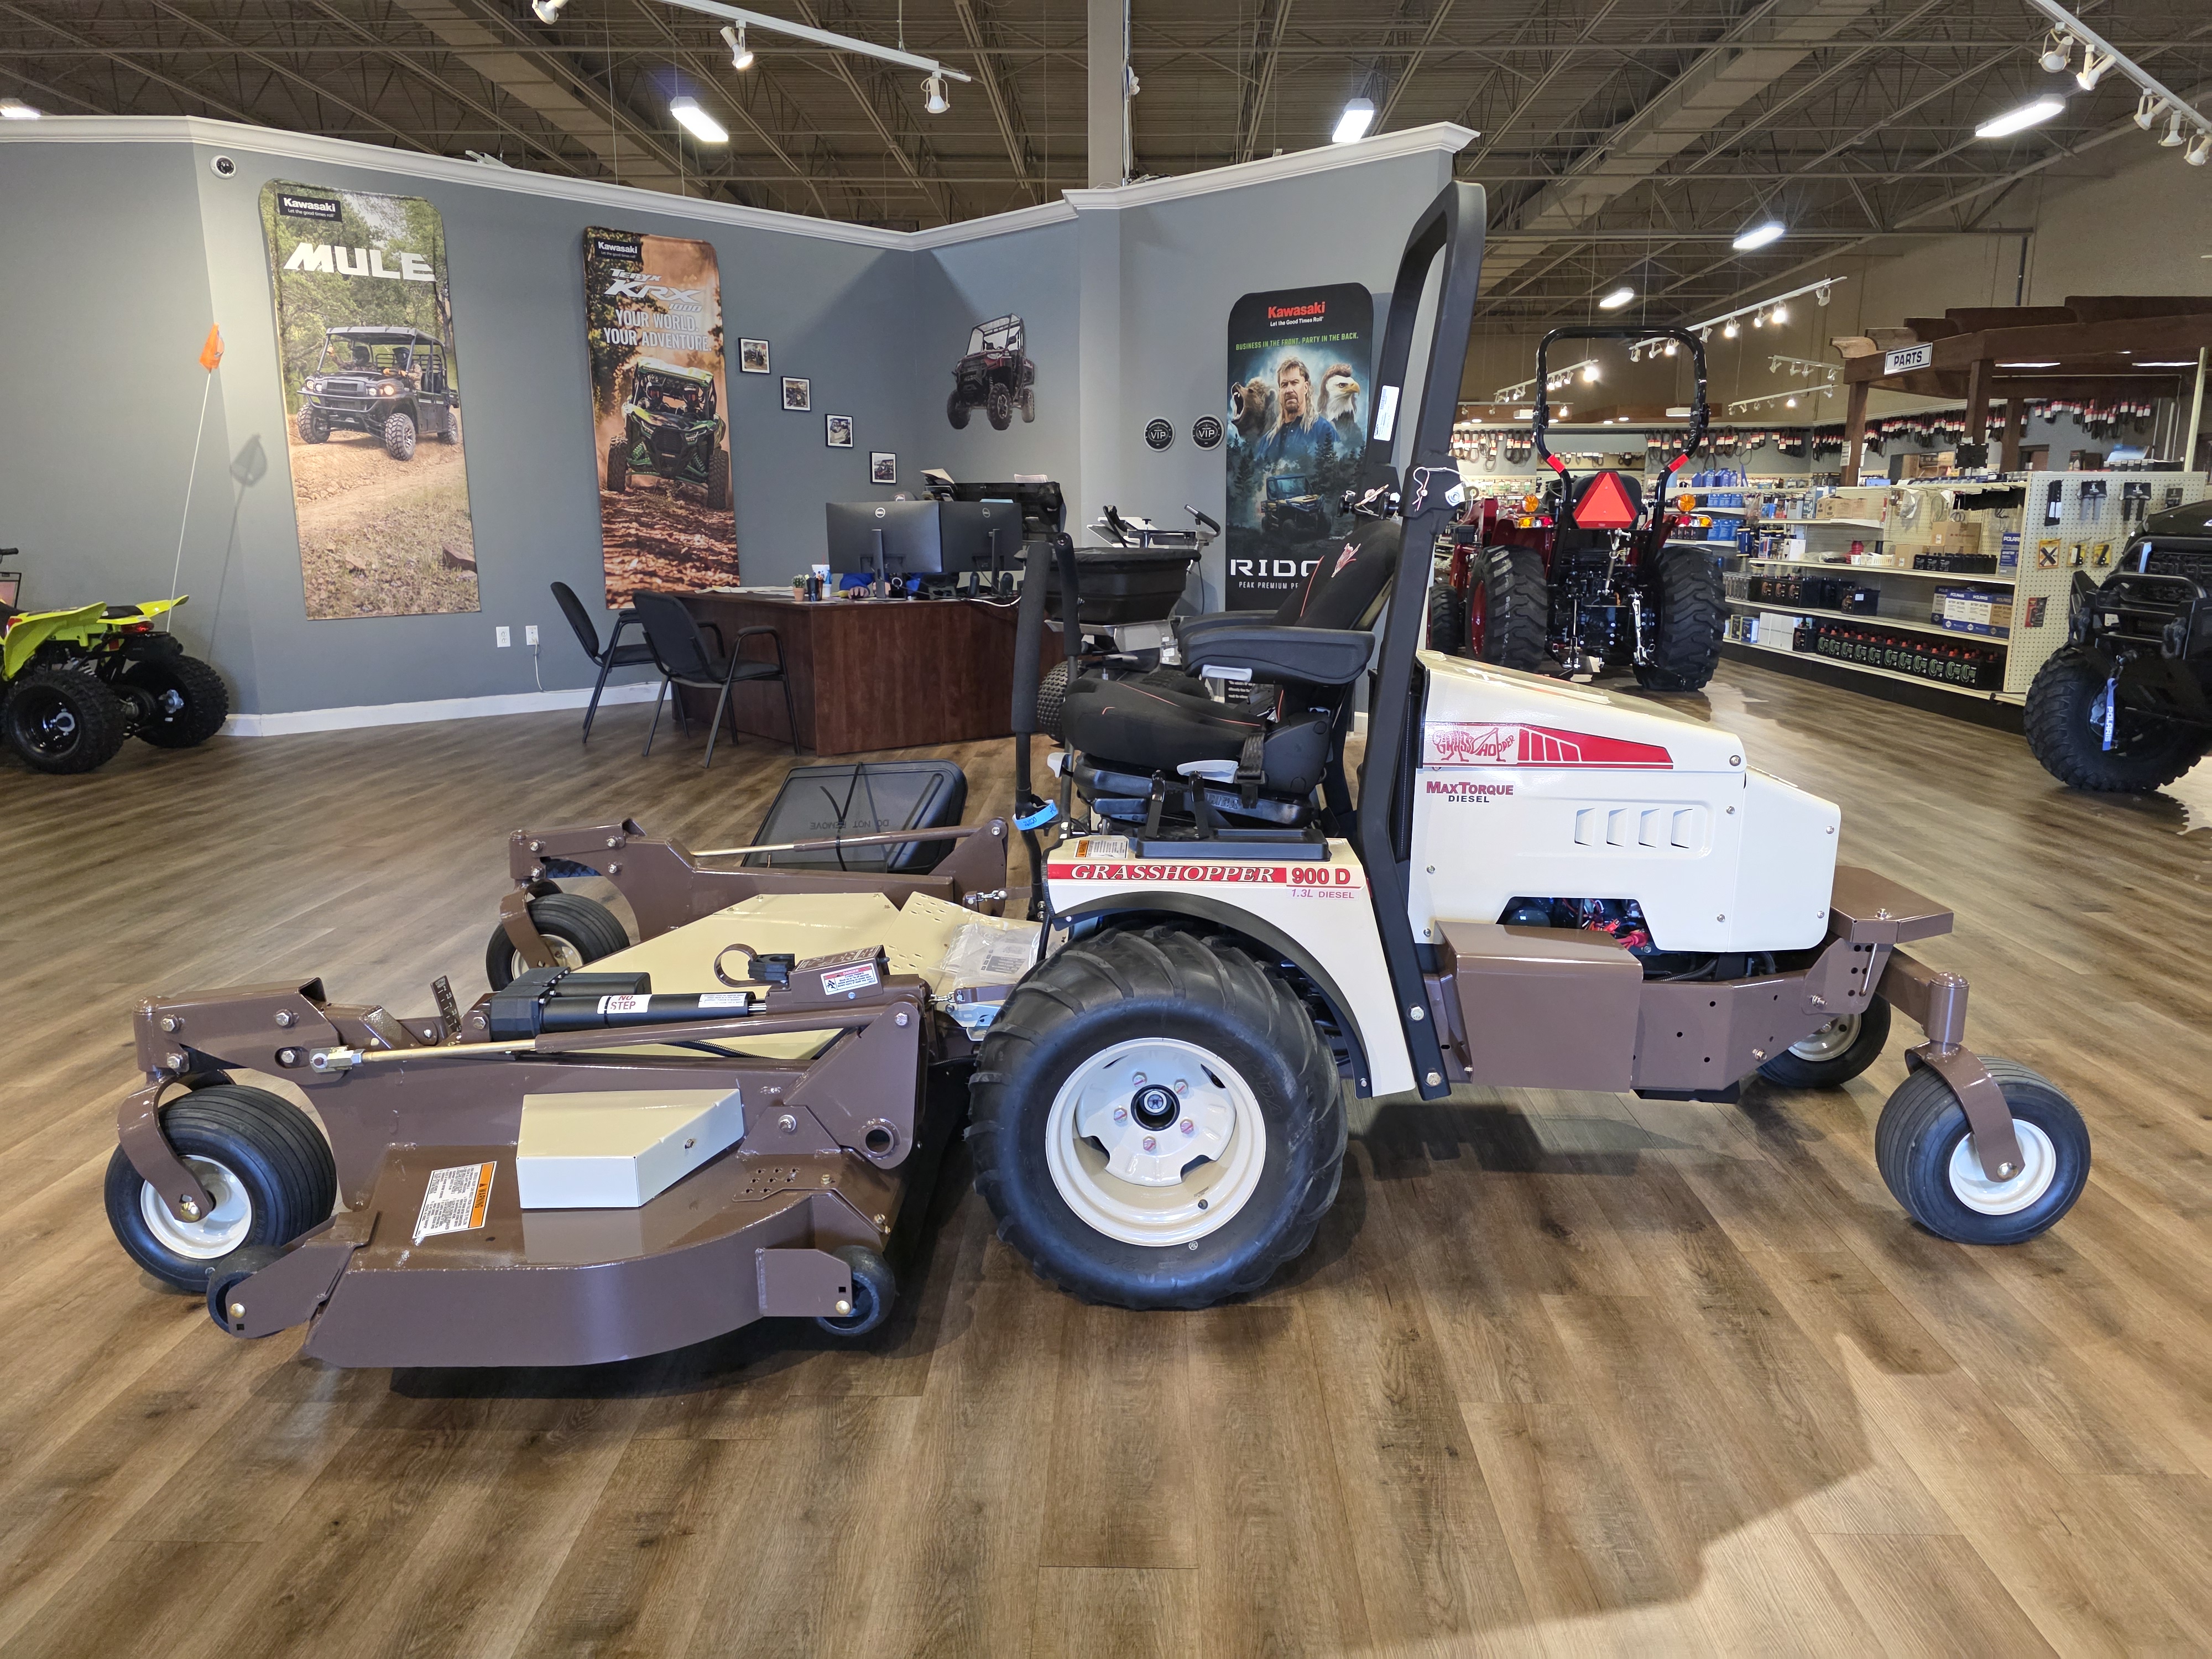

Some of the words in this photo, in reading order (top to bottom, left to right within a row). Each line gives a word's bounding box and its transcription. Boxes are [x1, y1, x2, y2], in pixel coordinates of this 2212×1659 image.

[283, 197, 336, 212] Kawasaki
[598, 242, 637, 254] Kawasaki
[283, 242, 436, 281] MULE
[610, 268, 662, 281] TERYX
[604, 279, 703, 304] KRX
[669, 304, 702, 312] 1000
[1268, 301, 1326, 319] Kawasaki
[615, 310, 649, 327] YOUR
[653, 314, 699, 331] WORLD.
[603, 327, 638, 345] YOUR
[642, 332, 712, 351] ADVENTURE.
[1235, 342, 1261, 350] BUSINESS
[1341, 332, 1359, 340] BACK.
[1894, 351, 1922, 367] PARTS
[2104, 706, 2113, 742] POLARIS
[1448, 795, 1490, 803] DIESEL
[1071, 865, 1274, 882] GRASSHOPPER
[1292, 867, 1330, 884] 900
[1335, 868, 1350, 885] D
[1291, 888, 1313, 898] 1.3L
[611, 1001, 635, 1010] STEP
